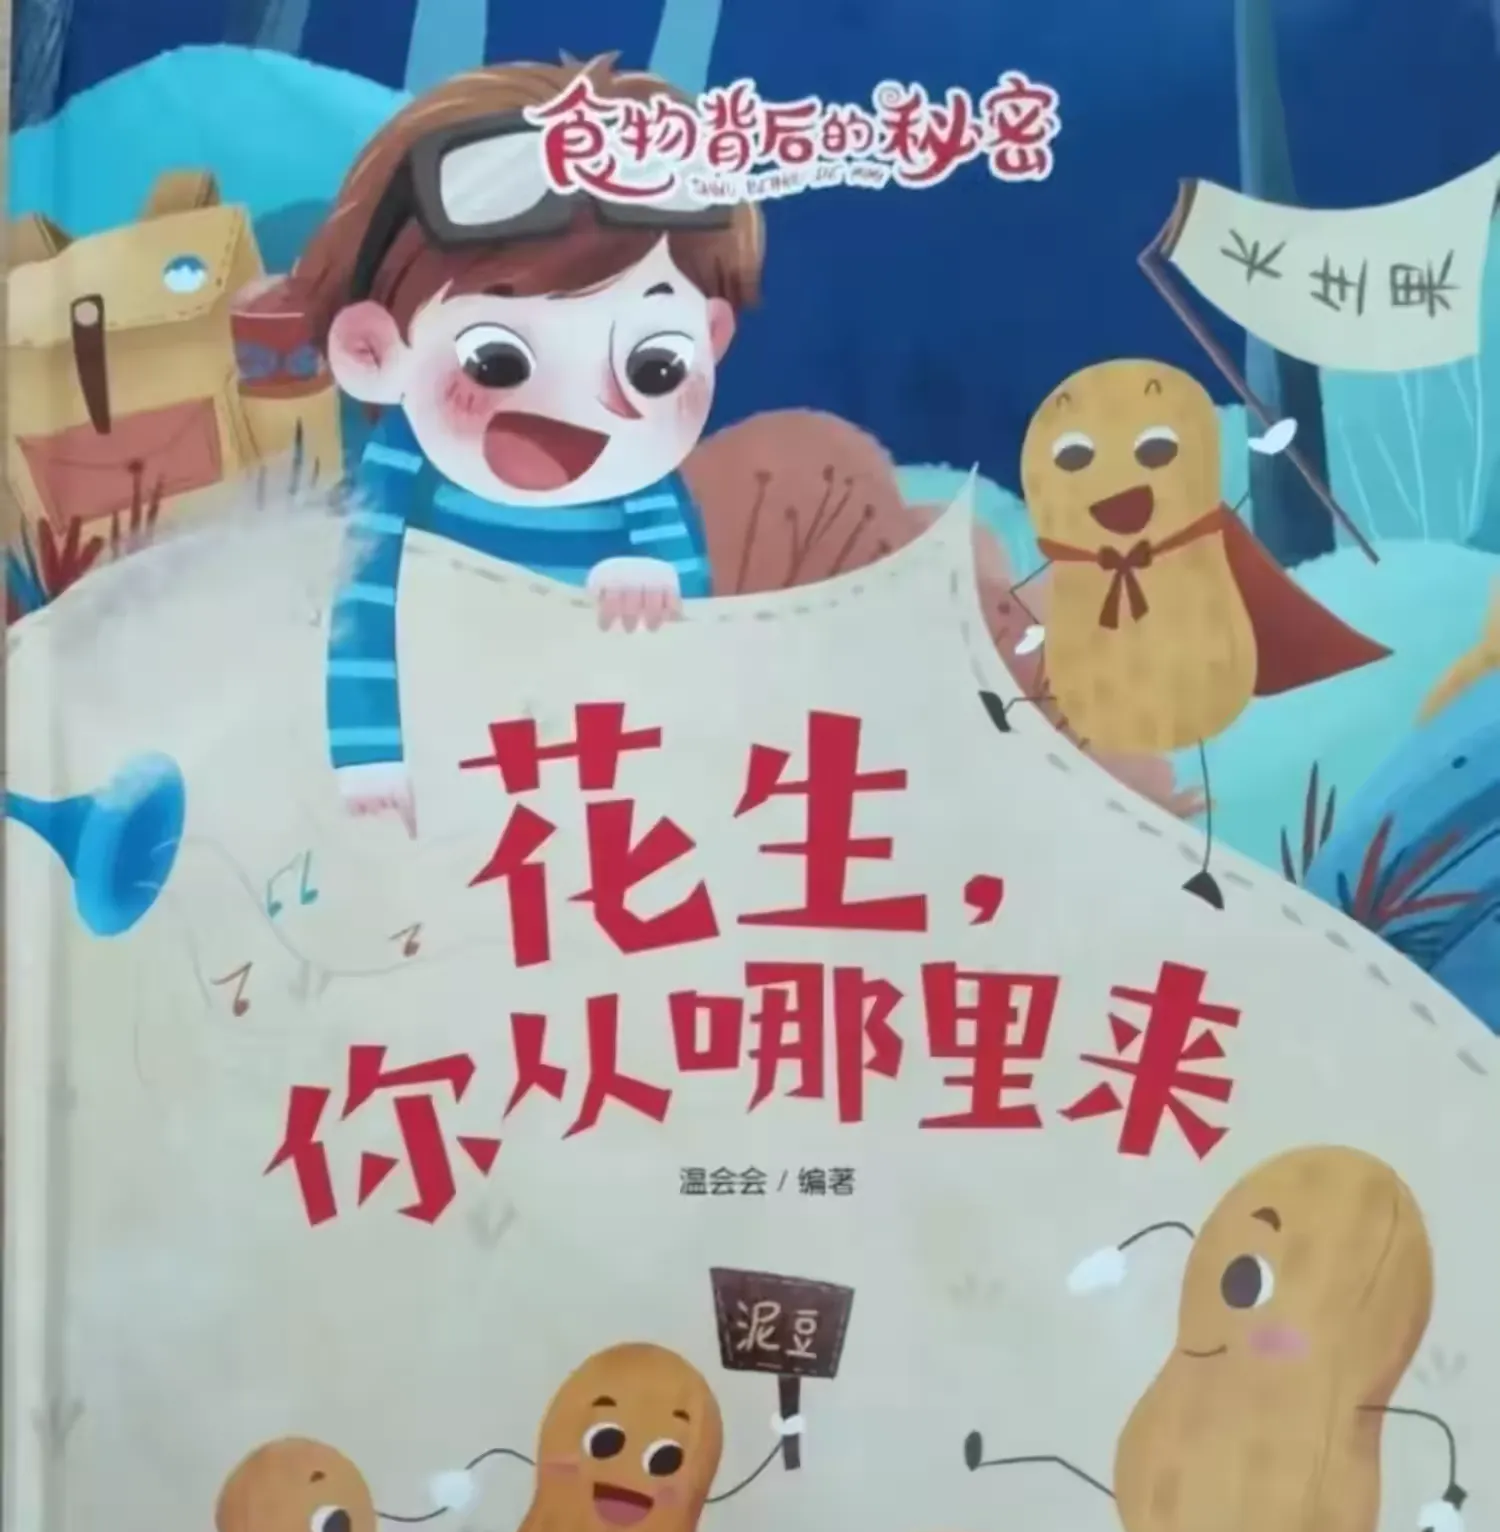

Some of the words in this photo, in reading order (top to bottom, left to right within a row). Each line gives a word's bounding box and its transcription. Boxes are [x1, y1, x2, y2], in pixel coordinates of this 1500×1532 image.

[531, 76, 1056, 197] 食物背后的秘密
[1219, 227, 1462, 319] 长生果
[263, 960, 1242, 1226] 你从哪里来
[679, 1165, 768, 1196] 温会会
[798, 1165, 857, 1197] 编著
[736, 1299, 820, 1359] 泥豆
